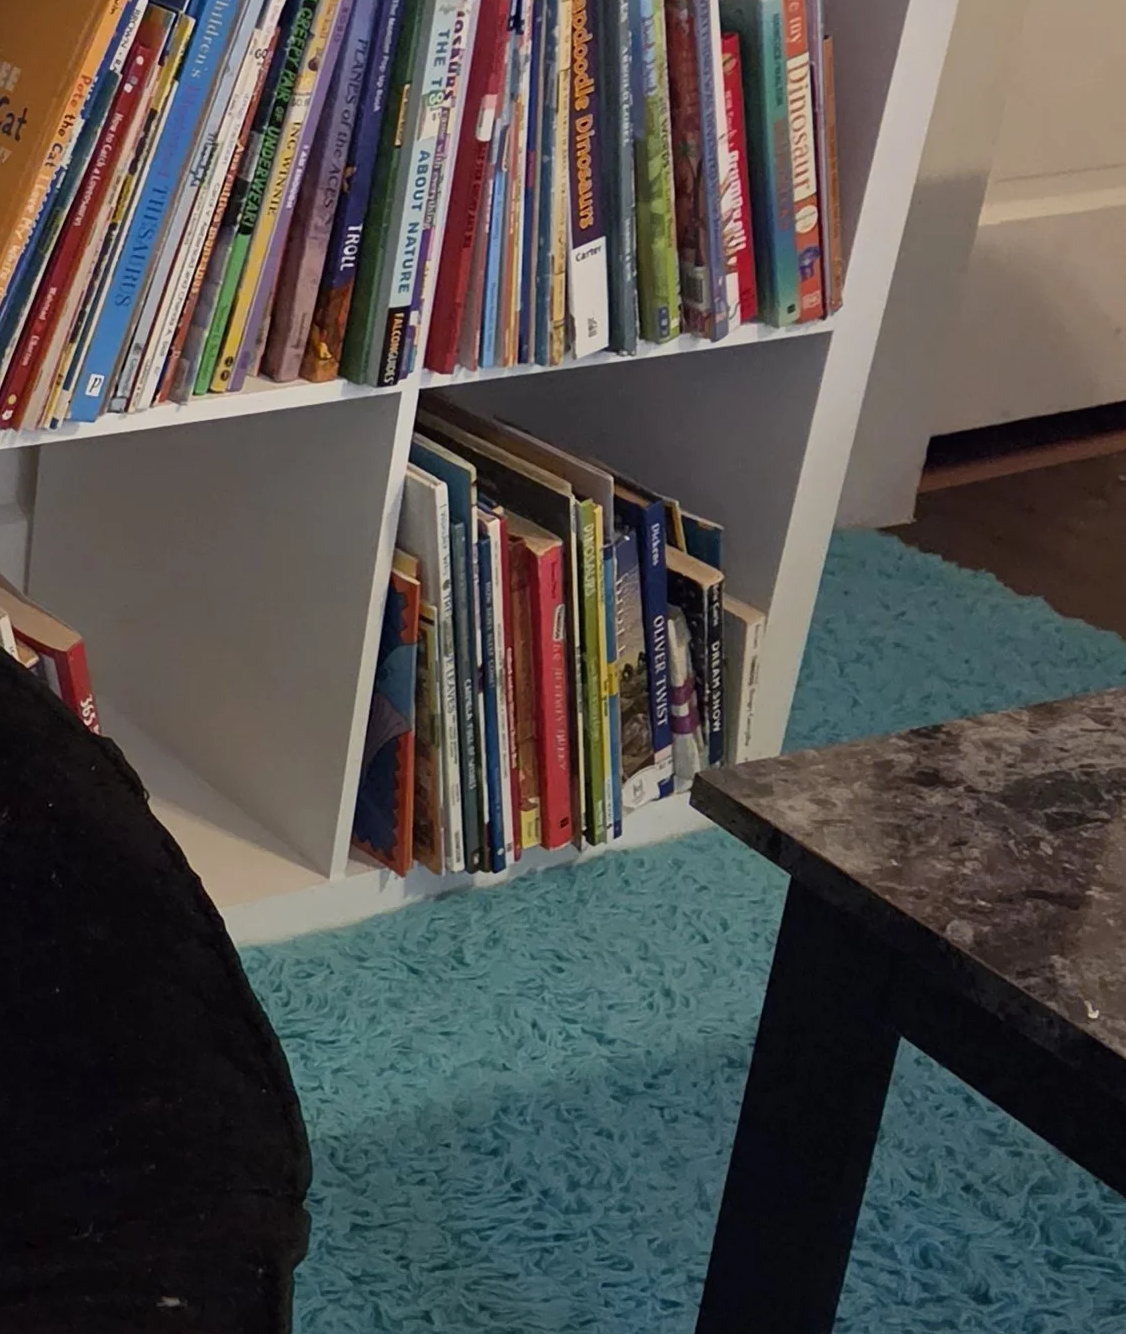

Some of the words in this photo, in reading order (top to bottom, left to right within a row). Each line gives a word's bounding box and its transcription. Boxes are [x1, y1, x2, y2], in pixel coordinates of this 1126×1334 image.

[286, 6, 314, 67] CREEPY
[433, 27, 450, 68] THE
[787, 17, 803, 44] my
[68, 73, 92, 110] Pete
[276, 69, 296, 103] PAIR
[343, 38, 369, 105] PLANES
[56, 112, 76, 139] the
[338, 107, 354, 128] of
[788, 56, 817, 193] Dinosaur
[44, 141, 64, 170] Cat
[95, 141, 113, 169] Catch
[332, 130, 349, 159] the
[241, 125, 282, 229] UNDERWEAR!
[320, 162, 342, 209] ACES
[410, 149, 430, 211] ABOUT
[572, 113, 595, 229] Dinosaurs
[111, 181, 171, 310] THESAURUS
[338, 220, 363, 273] TROLL
[397, 221, 419, 295] NATURE
[575, 246, 602, 262] Carter
[382, 311, 403, 386] FALCONGUIDES
[582, 522, 596, 597] DINOSAURS
[649, 522, 661, 566] Dickens
[652, 615, 666, 673] OLIVER
[710, 640, 721, 688] DREAM
[80, 694, 96, 726] 365
[445, 668, 456, 713] LEAVES
[655, 675, 668, 725] TWIST
[711, 690, 721, 732] SNOW
